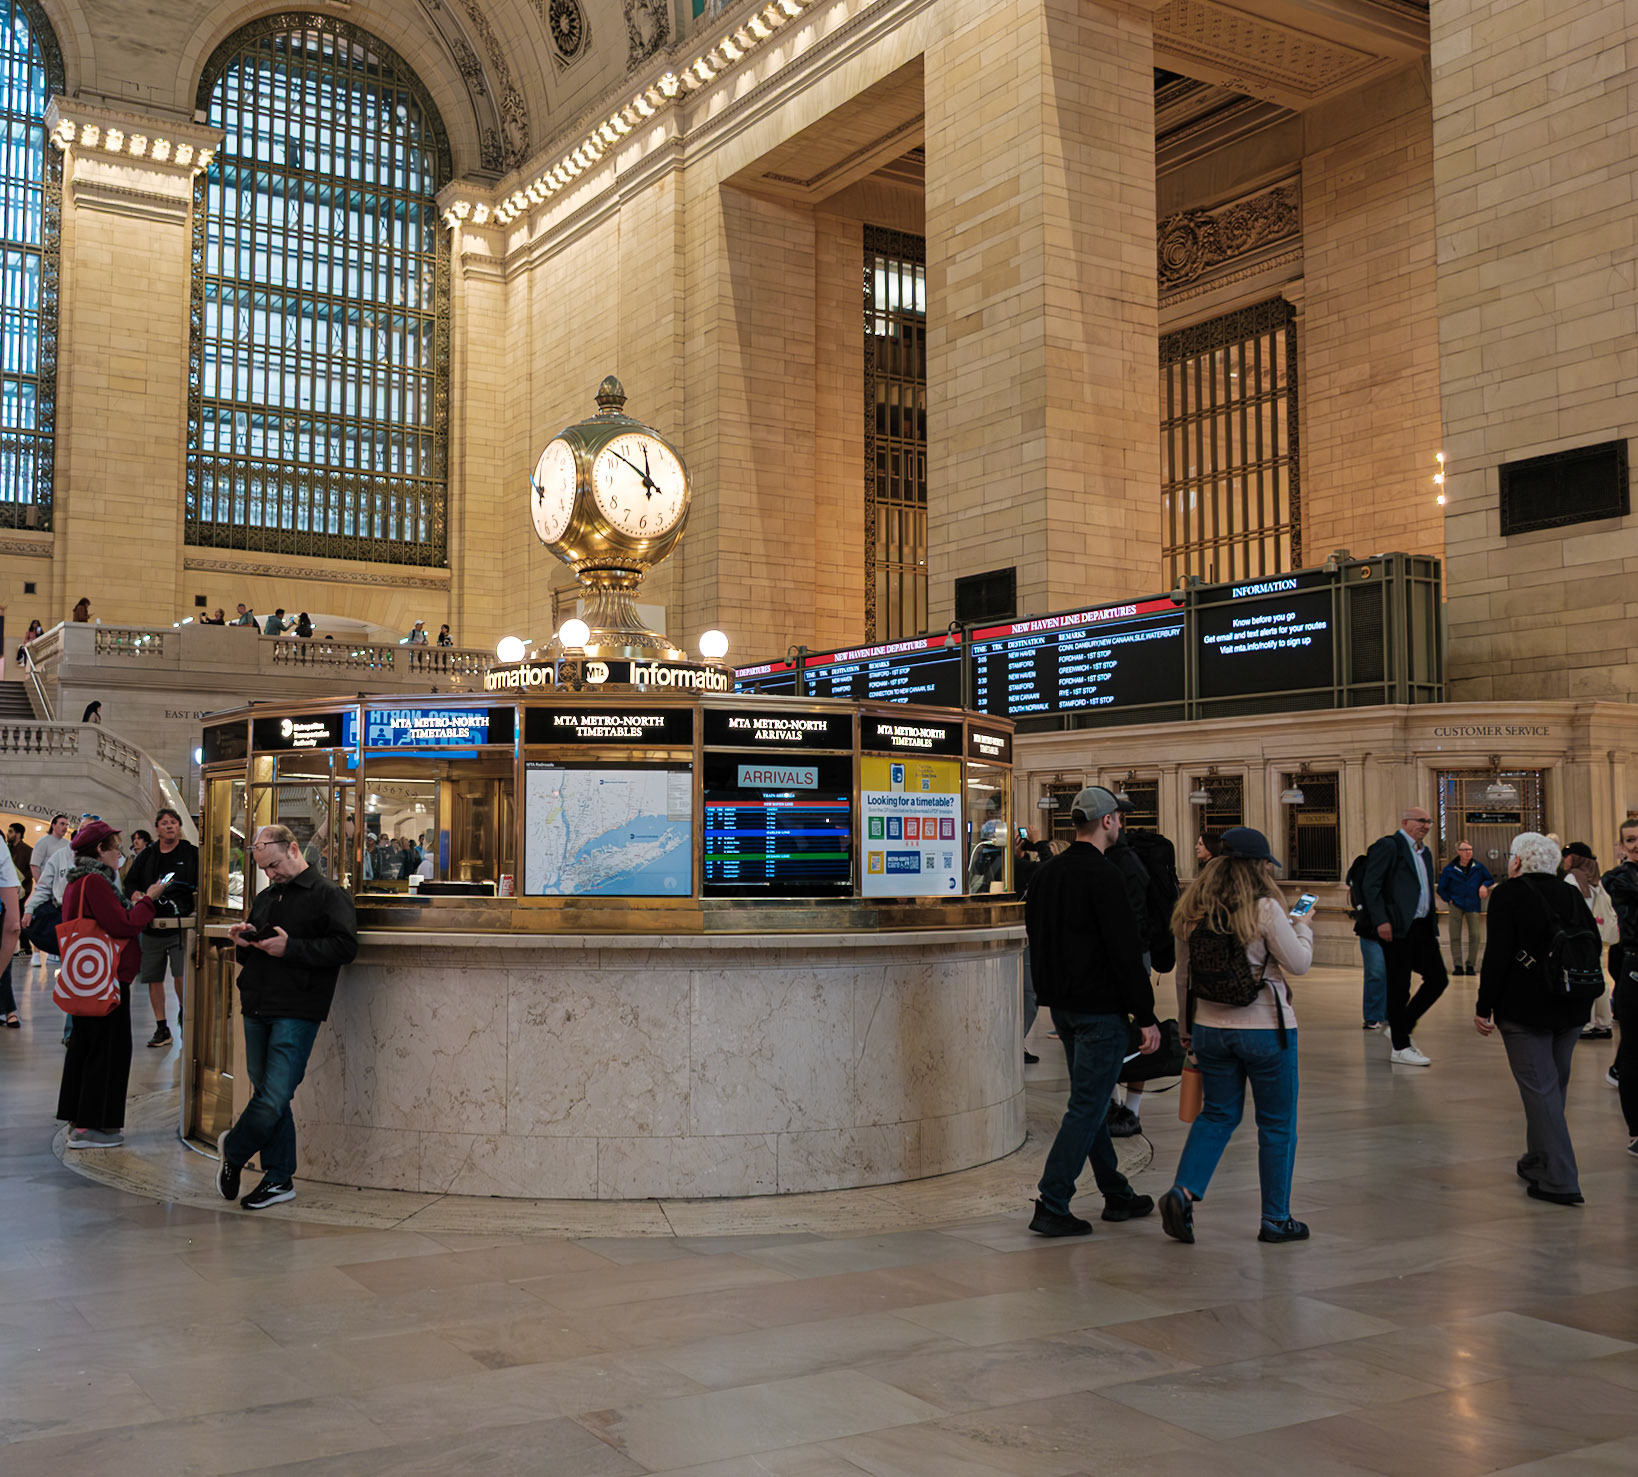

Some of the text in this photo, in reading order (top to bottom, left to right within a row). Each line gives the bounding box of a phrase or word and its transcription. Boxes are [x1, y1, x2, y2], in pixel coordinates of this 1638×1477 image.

[610, 495, 618, 510] 8
[624, 508, 632, 522] 7
[640, 514, 648, 529] 6
[656, 513, 663, 526] 5
[1232, 579, 1297, 598] INFORMATION
[1011, 605, 1136, 634] NEW HAVEN LINE DEPARTURES
[1232, 612, 1296, 628] Know before you go
[1008, 636, 1046, 649] DESTINATION
[1058, 630, 1086, 642] REMARKS
[1204, 620, 1326, 644] Get email and text alerts for your routes
[834, 639, 927, 662] NEW HAVEN LINE DEPARTURES
[1220, 636, 1312, 654] Visit mta.info/notify to sign up
[1008, 651, 1018, 659] NEW
[1018, 650, 1036, 658] HAVEN
[1008, 660, 1034, 670] STAMFORD
[1058, 654, 1084, 663] FORDHAM
[1086, 652, 1096, 660] 1ST
[1096, 650, 1112, 658] STOP
[740, 664, 771, 677] DEPARTURES
[831, 665, 860, 675] DESTINATION
[868, 660, 890, 670] REMARKS
[1008, 673, 1018, 681] NEW
[1018, 671, 1036, 680] HAVEN
[1058, 664, 1089, 674] GREENWICH
[1092, 662, 1102, 670] 1ST
[1102, 660, 1118, 669] STOP
[630, 661, 728, 692] Information
[1008, 682, 1034, 692] STAMFORD
[1058, 676, 1084, 686] FORDHAM
[1096, 672, 1112, 681] STOP
[832, 686, 852, 694] STAMFORD
[868, 690, 894, 698] CONNECTION
[1019, 692, 1040, 702] CANAAN
[1058, 689, 1070, 698] RYE
[1072, 688, 1082, 696] 1ST
[1082, 686, 1096, 694] STOP
[1008, 696, 1114, 714] SOUTH NORWALK STAMFORD 1ST STOP
[166, 710, 204, 720] EAST B
[390, 716, 490, 728] MTA METRO-NORTH
[554, 716, 664, 727] MTA METRO-NORTH
[576, 727, 642, 737] TIMETABLES
[728, 718, 828, 731] MTA METRO-NORTH
[877, 724, 946, 739] MTA METRO-NORTH
[1434, 726, 1550, 736] CUSTOMER SERVICE
[410, 728, 470, 738] TIMETABLES
[754, 730, 802, 740] ARRIVALS
[891, 736, 932, 748] TIMETABLES
[743, 770, 814, 785] ARRIVALS
[868, 795, 898, 808] Looking
[898, 796, 910, 806] for
[916, 797, 954, 807] timetable?
